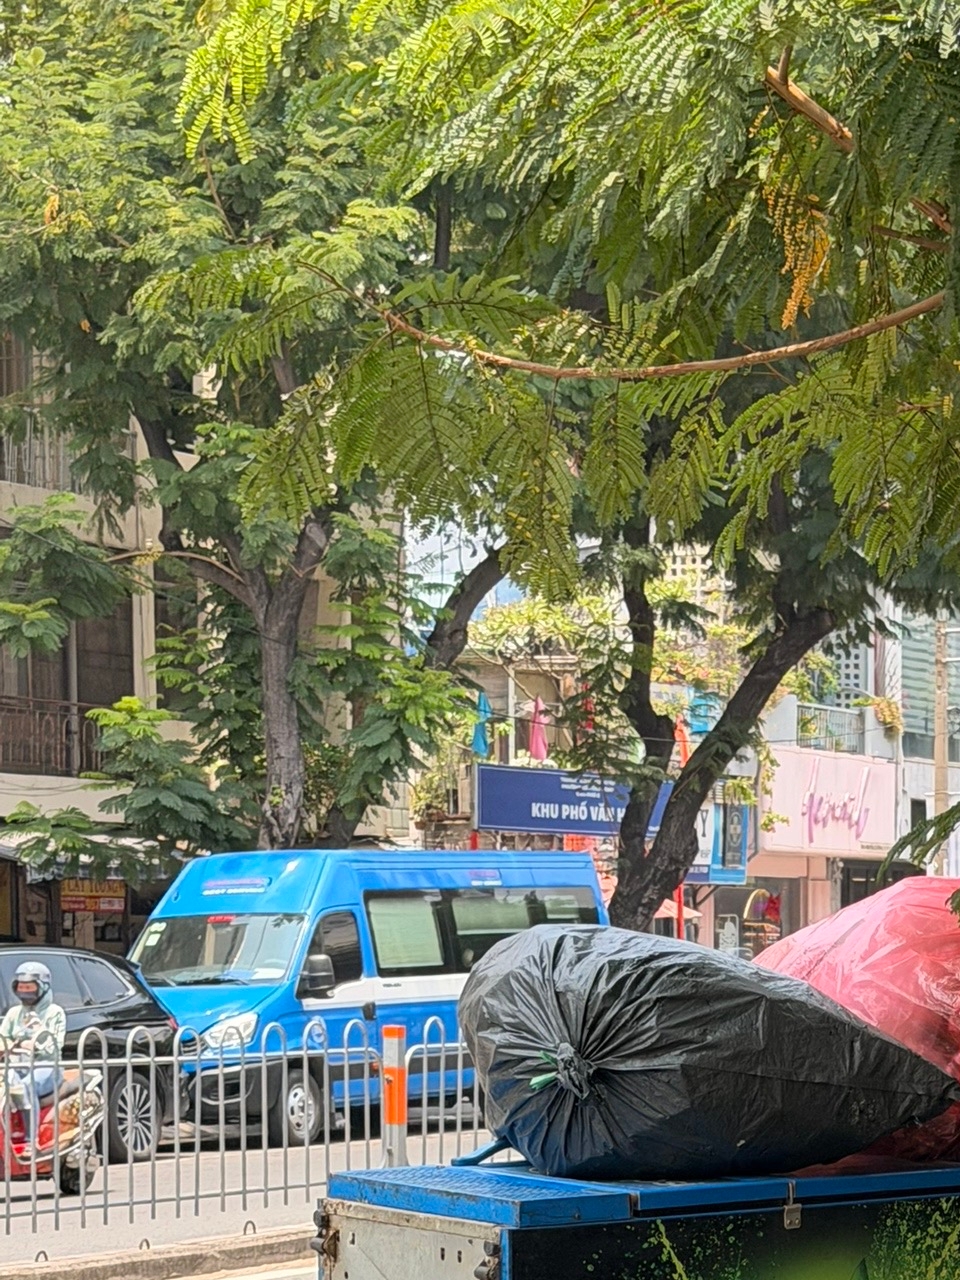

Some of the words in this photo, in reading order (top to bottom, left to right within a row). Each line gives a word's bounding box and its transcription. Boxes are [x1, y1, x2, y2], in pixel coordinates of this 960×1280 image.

[532, 802, 559, 818] KHU
[562, 800, 588, 821] PHỐ
[590, 803, 615, 823] VĂN
